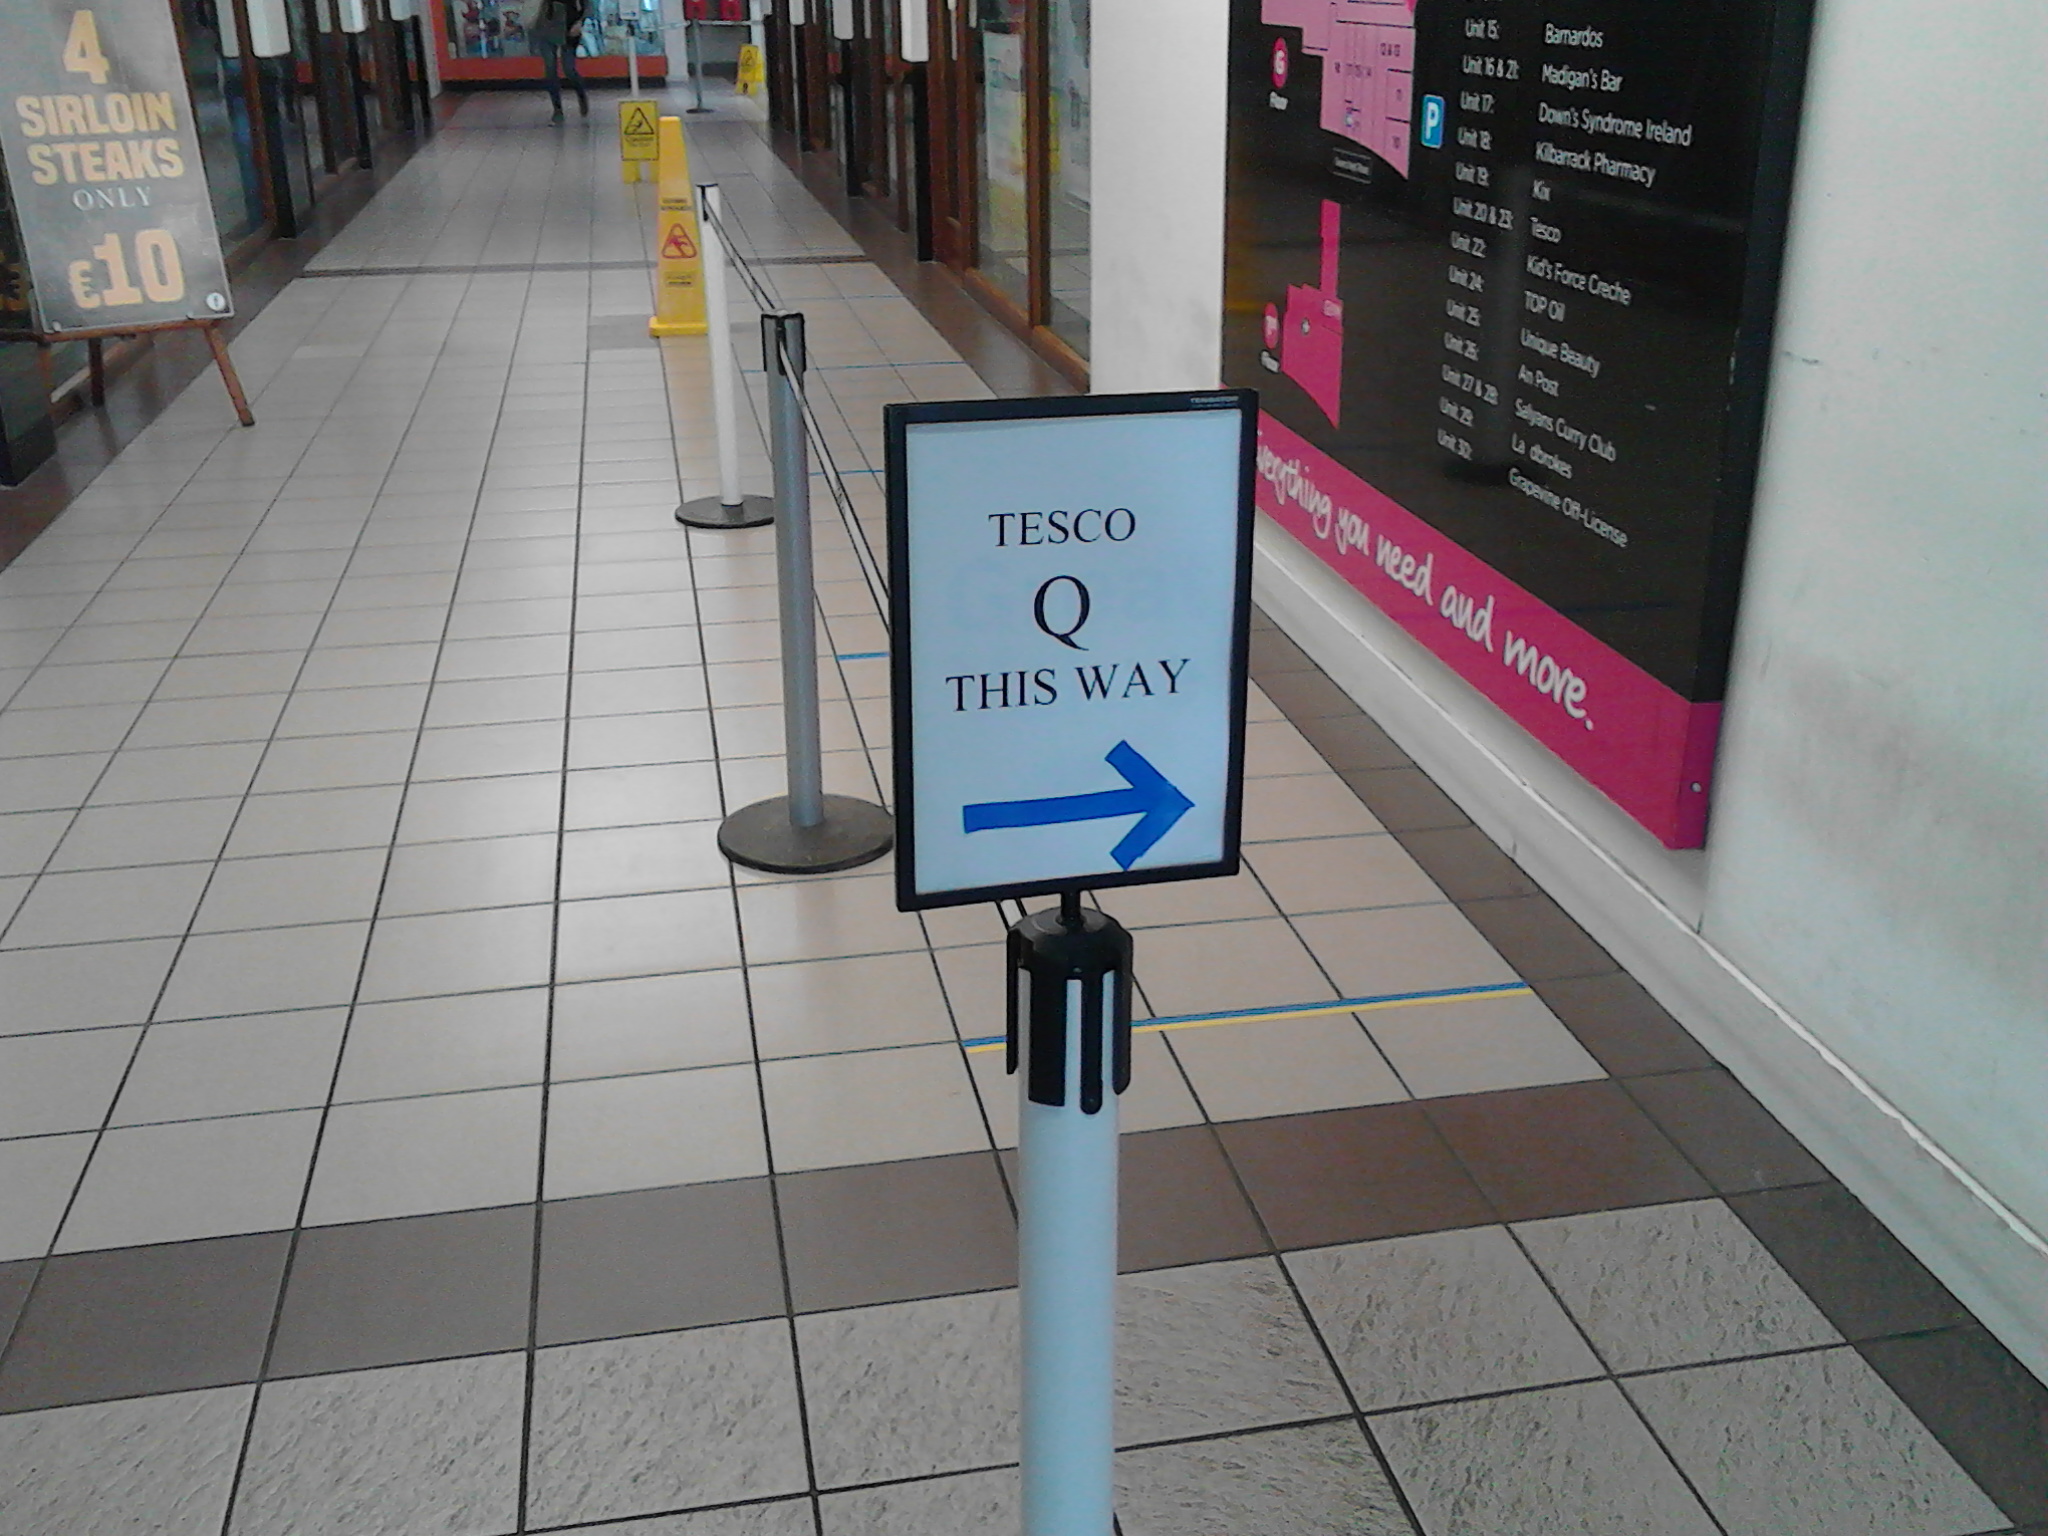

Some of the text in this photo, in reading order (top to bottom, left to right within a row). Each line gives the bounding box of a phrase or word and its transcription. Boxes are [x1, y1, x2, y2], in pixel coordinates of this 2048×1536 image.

[62, 9, 110, 84] 4
[1465, 18, 1604, 48] Unit 15: Barnardos
[1463, 55, 1482, 76] Unit
[1484, 56, 1495, 76] 16
[1542, 63, 1598, 90] Madigan's
[1600, 69, 1623, 92] Bar
[15, 91, 177, 137] SIRLOIN
[1460, 90, 1693, 147] Unit 17: Down's Syndrome Ireland
[27, 138, 184, 185] STEAKS
[1455, 161, 1475, 183] Unit
[1457, 126, 1477, 148] Unit
[1535, 141, 1591, 172] Kilbarrack
[1593, 152, 1657, 188] Pharmacy
[72, 186, 151, 211] ONLY
[1453, 196, 1473, 218] Unit
[1474, 201, 1488, 222] 20
[1530, 216, 1563, 243] Tesco
[68, 229, 185, 309] €10
[1448, 264, 1468, 287] Unit
[1524, 290, 1548, 314] TOP
[1450, 230, 1471, 253] Unit
[1526, 254, 1553, 280] Kid's
[1554, 262, 1586, 291] Force
[1588, 273, 1632, 306] Creche
[1444, 331, 1463, 355] Unit
[1518, 364, 1534, 385] An
[1534, 370, 1560, 397] Post
[1446, 298, 1466, 322] Unit
[1520, 327, 1559, 358] Unique
[1560, 342, 1600, 378] Beauty
[1439, 396, 1459, 420] Unit
[1442, 363, 1461, 387] Unit
[1556, 417, 1587, 451] Curry
[1588, 433, 1616, 462] Club
[1437, 427, 1457, 452] Unit
[1509, 467, 1561, 511] Grapevine
[1562, 496, 1628, 548] Off-License
[988, 508, 1136, 547] TESCO
[1256, 437, 1594, 731] verything you need and more.
[1034, 575, 1091, 651] Q
[945, 658, 1191, 712] THIS WAY
